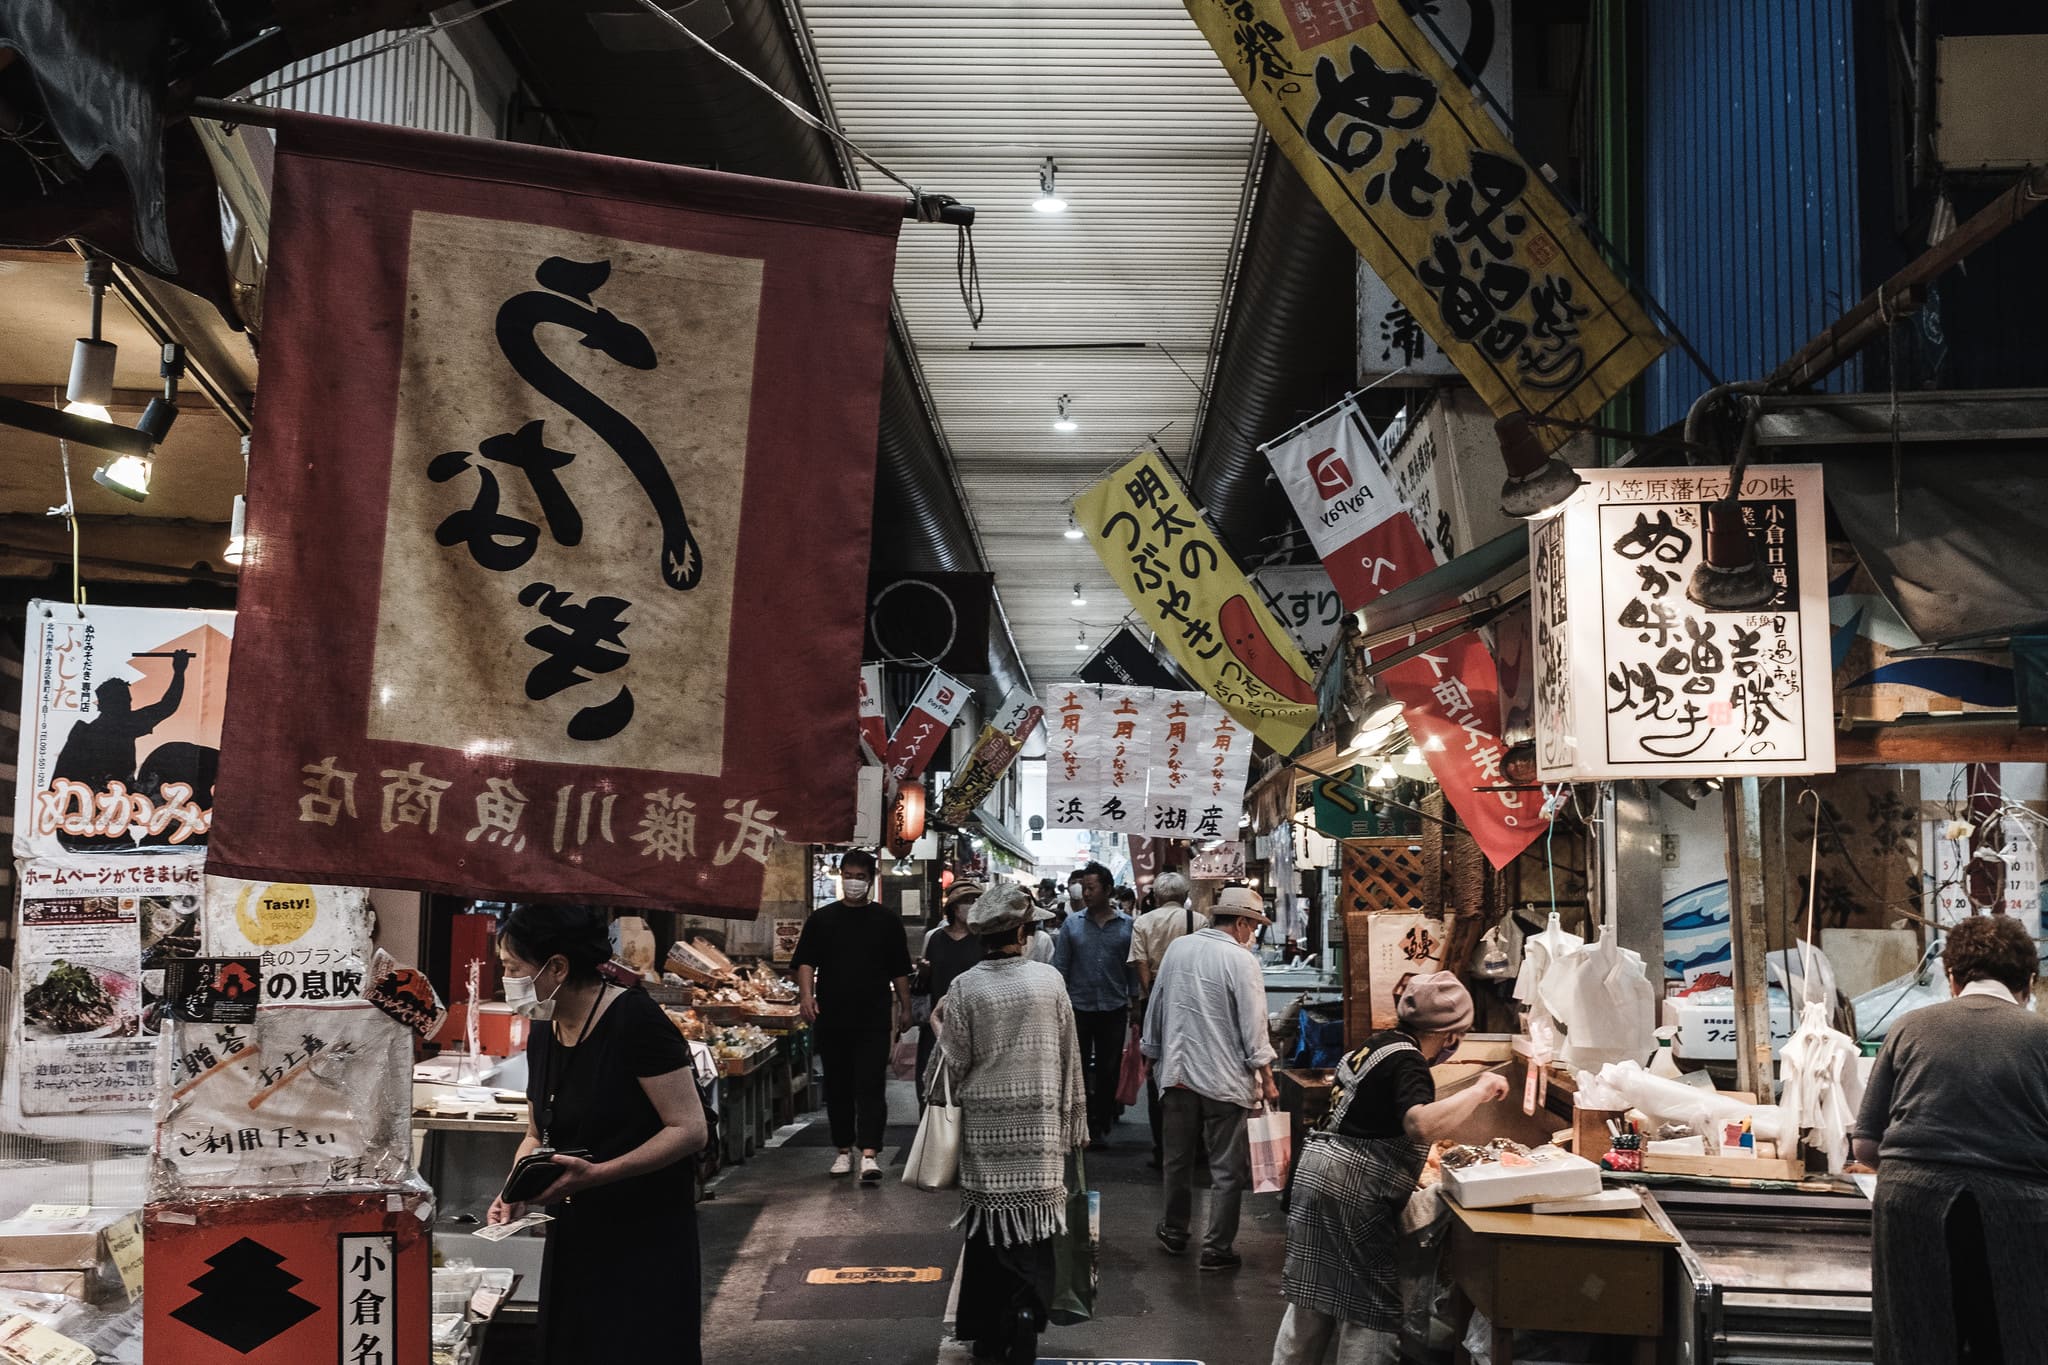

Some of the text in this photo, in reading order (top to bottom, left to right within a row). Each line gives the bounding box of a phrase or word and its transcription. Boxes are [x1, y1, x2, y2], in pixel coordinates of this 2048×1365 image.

[1125, 464, 1218, 579] 明太の
[1101, 511, 1223, 660] つぶやき
[54, 626, 82, 709] ふじた
[80, 624, 95, 713] ぬかみそだき 専門店
[927, 697, 950, 715] PayPay
[1059, 691, 1084, 781] 土用うなぎ
[1112, 697, 1139, 788] 土用うなぎ
[1166, 700, 1190, 789] 土用うなぎ
[1210, 717, 1237, 797] 土用うなぎ
[37, 778, 212, 845] ぬかみ
[1056, 795, 1224, 838] 浜名湖産
[25, 865, 200, 886] ホームページができました
[1943, 861, 1949, 870] 5
[2011, 880, 2021, 890] 17
[264, 898, 310, 911] Tasty!
[1955, 898, 1966, 908] 20
[2011, 899, 2022, 909] 24
[178, 1126, 336, 1157] ご利用下さい
